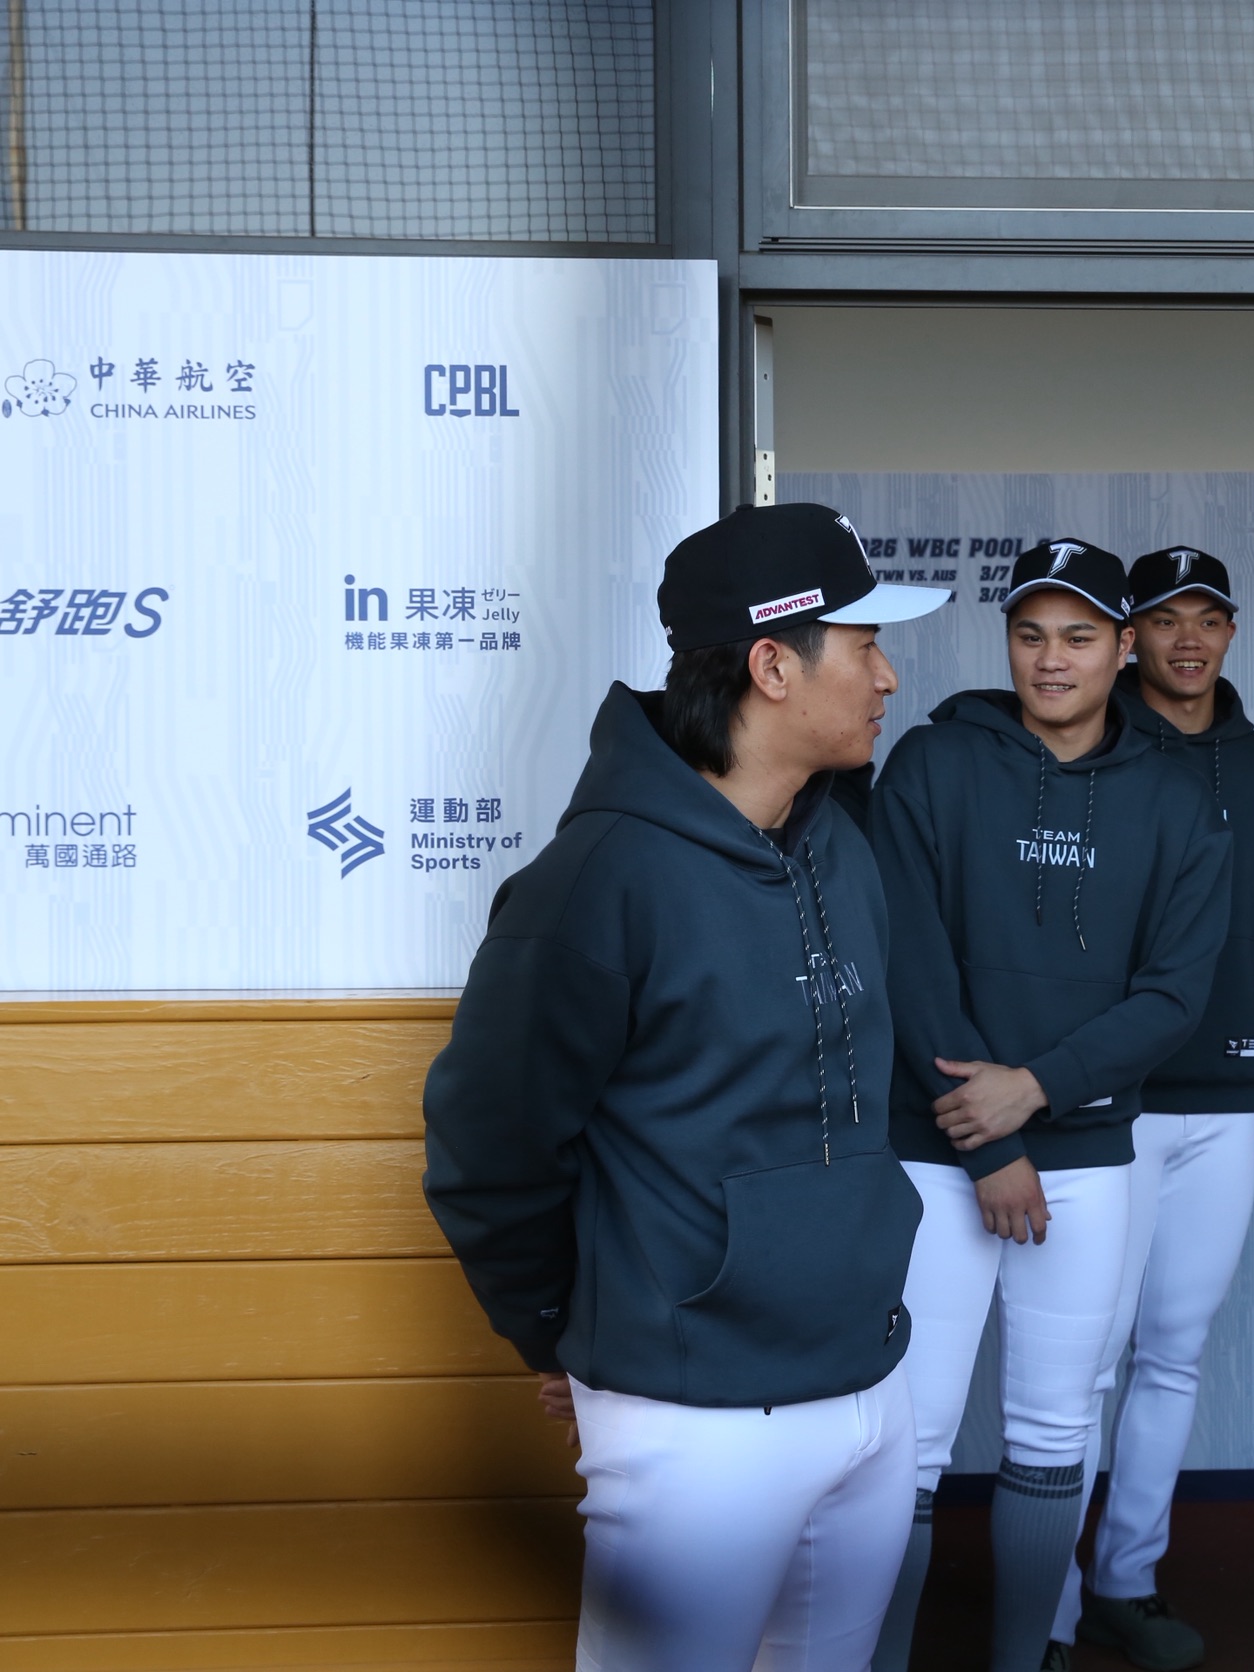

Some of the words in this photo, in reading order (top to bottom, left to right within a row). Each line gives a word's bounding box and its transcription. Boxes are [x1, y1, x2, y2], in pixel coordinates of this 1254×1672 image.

[90, 356, 256, 393] 中華航空
[424, 364, 520, 418] CPBL
[90, 404, 159, 420] CHINA
[164, 405, 256, 420] AIRLINES
[907, 538, 961, 558] WBC
[876, 570, 904, 581] TWN
[909, 570, 928, 581] VS.
[932, 570, 957, 581] AUS
[980, 566, 1010, 581] 3/7
[344, 574, 388, 621] in
[405, 587, 477, 621] 果凍
[482, 588, 520, 602] ゼリー
[979, 587, 1009, 603] 3/8
[482, 608, 520, 623] Jelly
[755, 594, 820, 620] ADVANTEST
[345, 631, 521, 651] 機能果凍第一品牌
[410, 798, 502, 823] 運動部
[411, 832, 497, 852] Ministry
[501, 832, 522, 849] of
[1032, 828, 1080, 843] TEAM
[25, 844, 137, 868] 萬國通路
[411, 854, 481, 873] Sports
